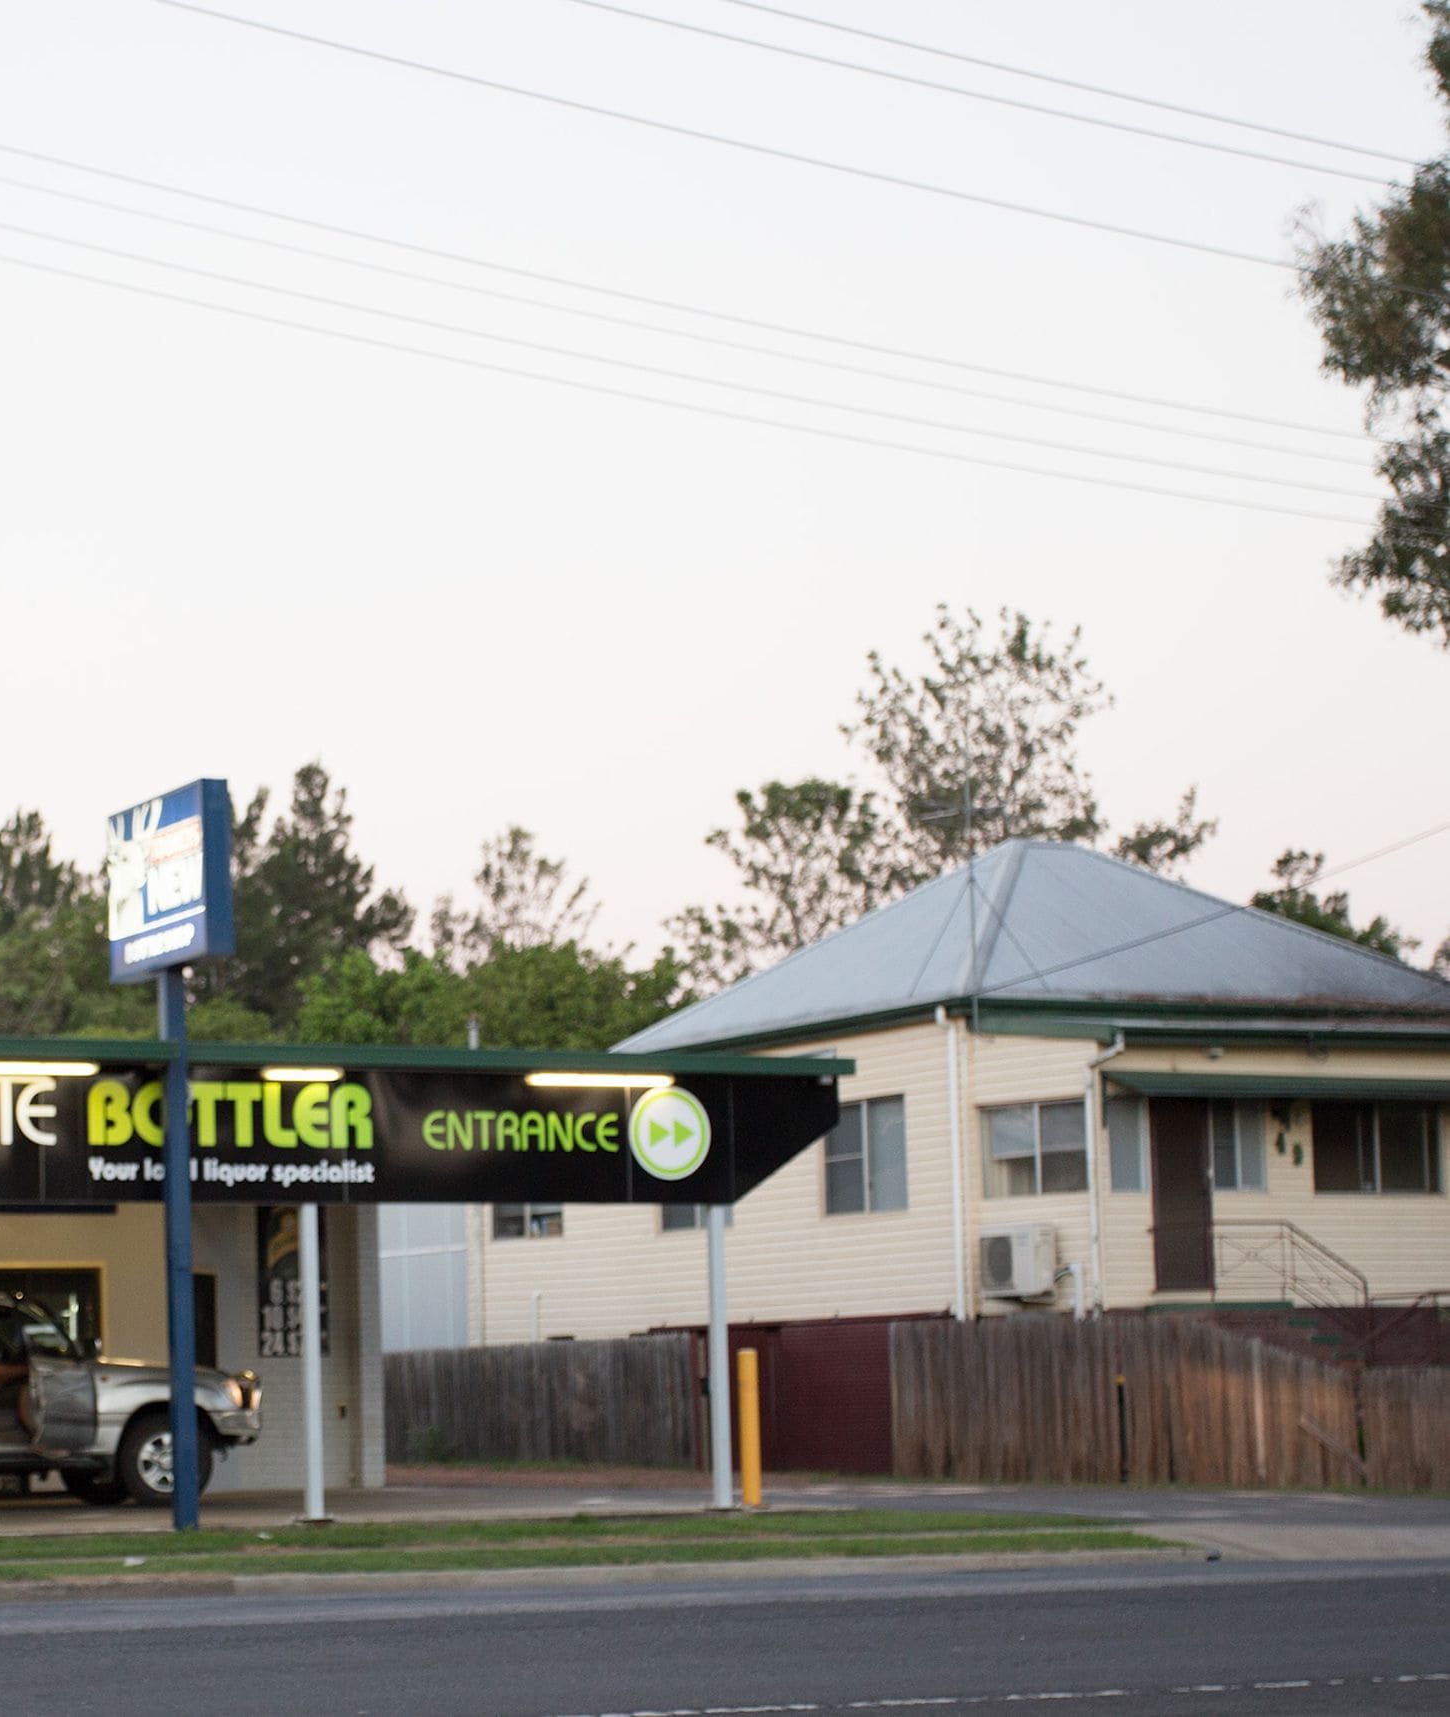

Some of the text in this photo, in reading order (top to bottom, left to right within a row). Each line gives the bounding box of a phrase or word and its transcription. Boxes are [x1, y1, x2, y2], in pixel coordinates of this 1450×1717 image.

[87, 1079, 375, 1149] BOTTLER
[421, 1109, 620, 1153] ENTRANCE
[87, 1156, 375, 1188] Your lol liquor specialist
